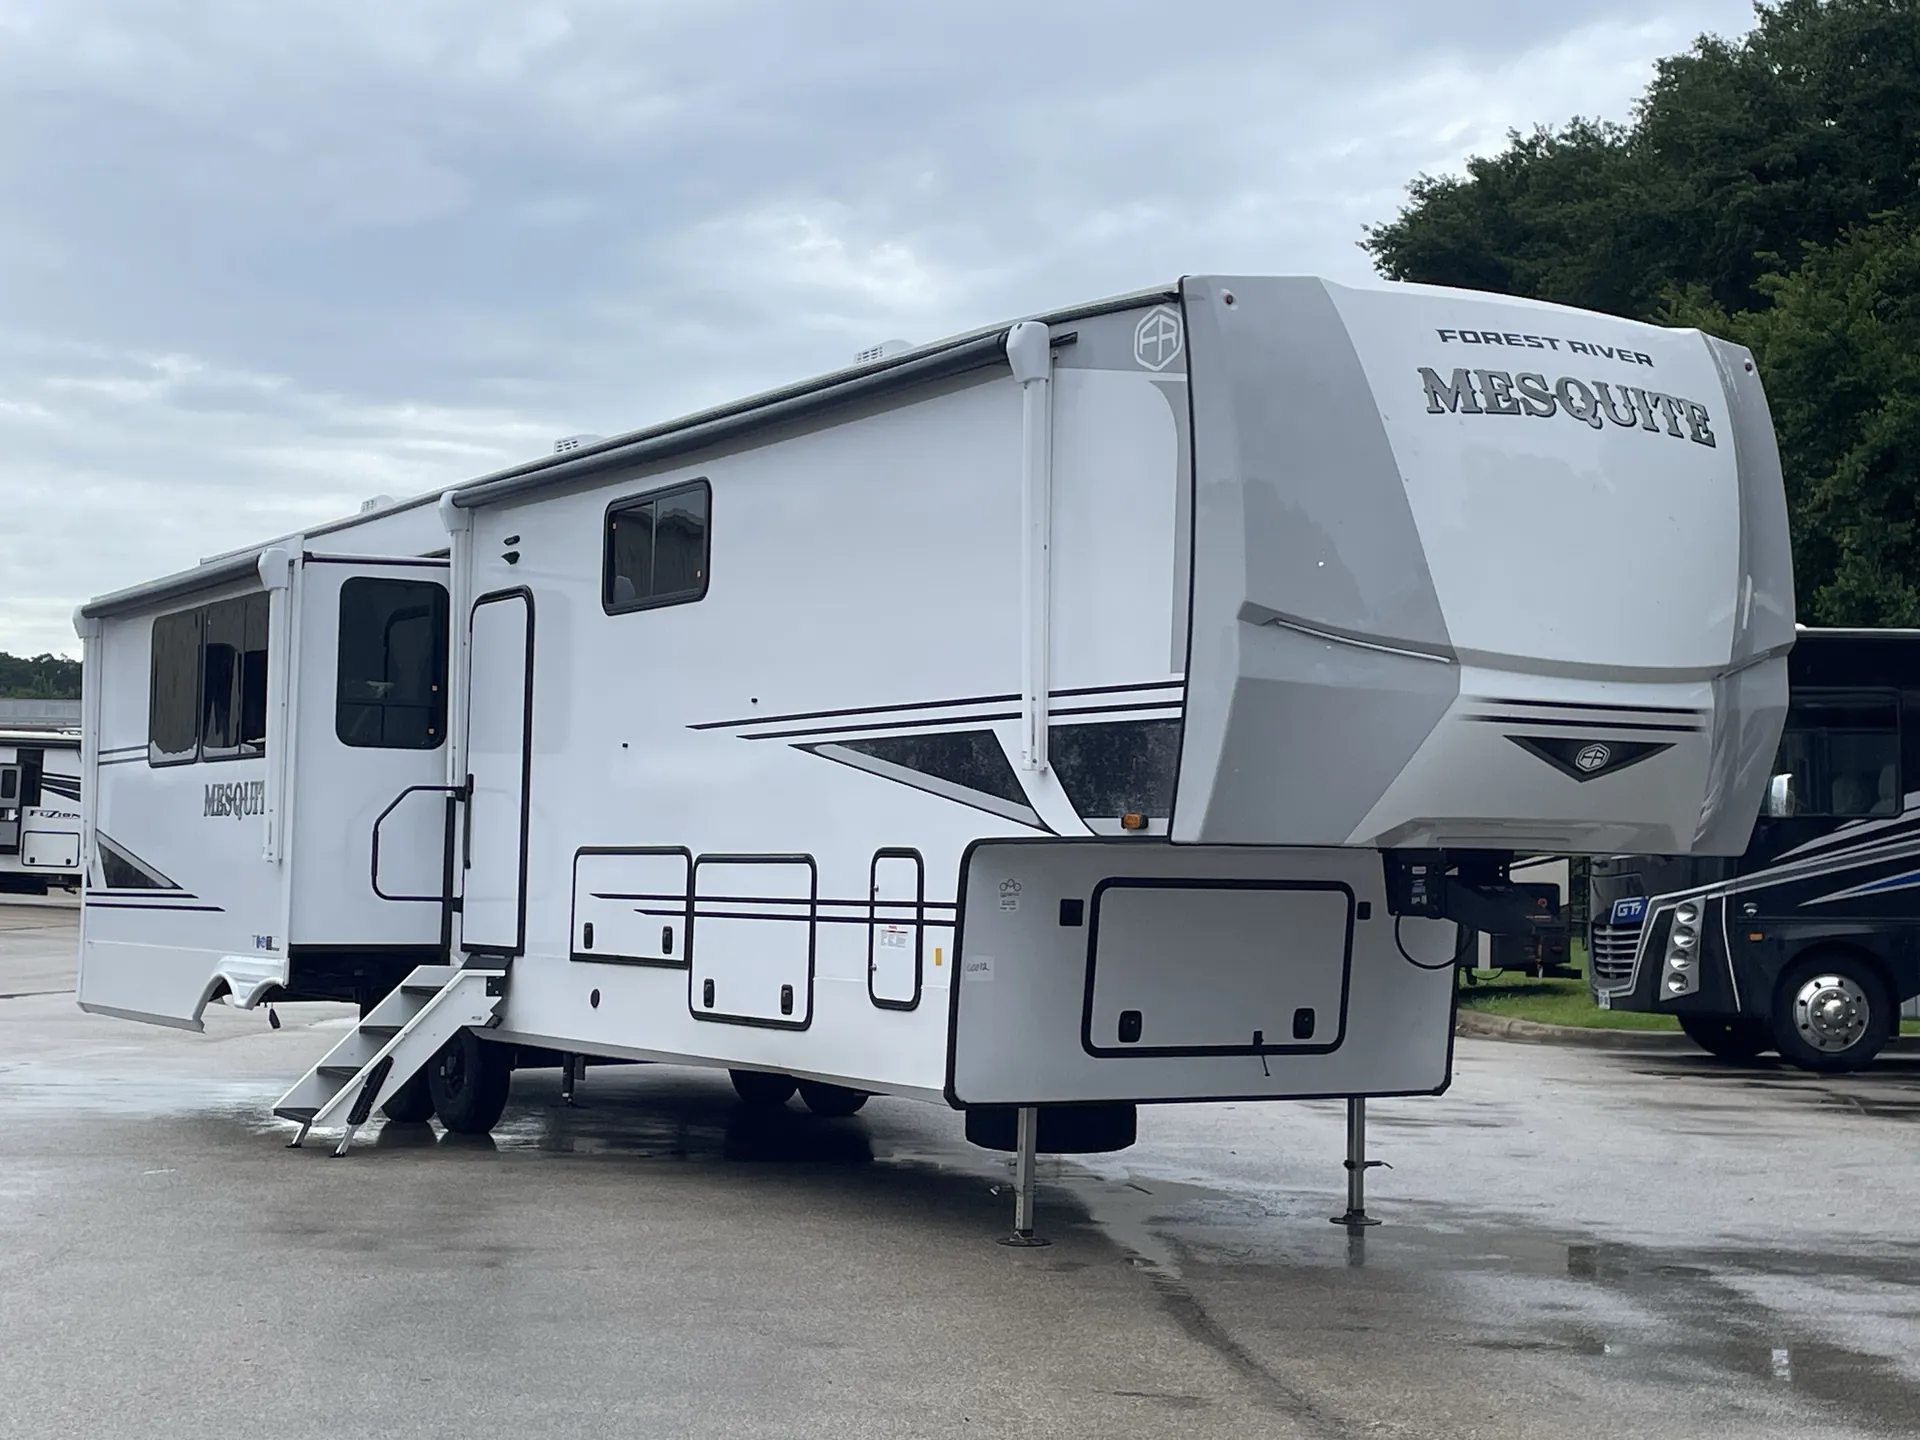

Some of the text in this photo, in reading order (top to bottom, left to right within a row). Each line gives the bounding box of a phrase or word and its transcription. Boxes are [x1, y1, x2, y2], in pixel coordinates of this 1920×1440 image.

[1435, 328, 1655, 368] FOREST RIVER
[1416, 366, 1717, 449] MESQUITE
[203, 780, 265, 821] MESQUIT
